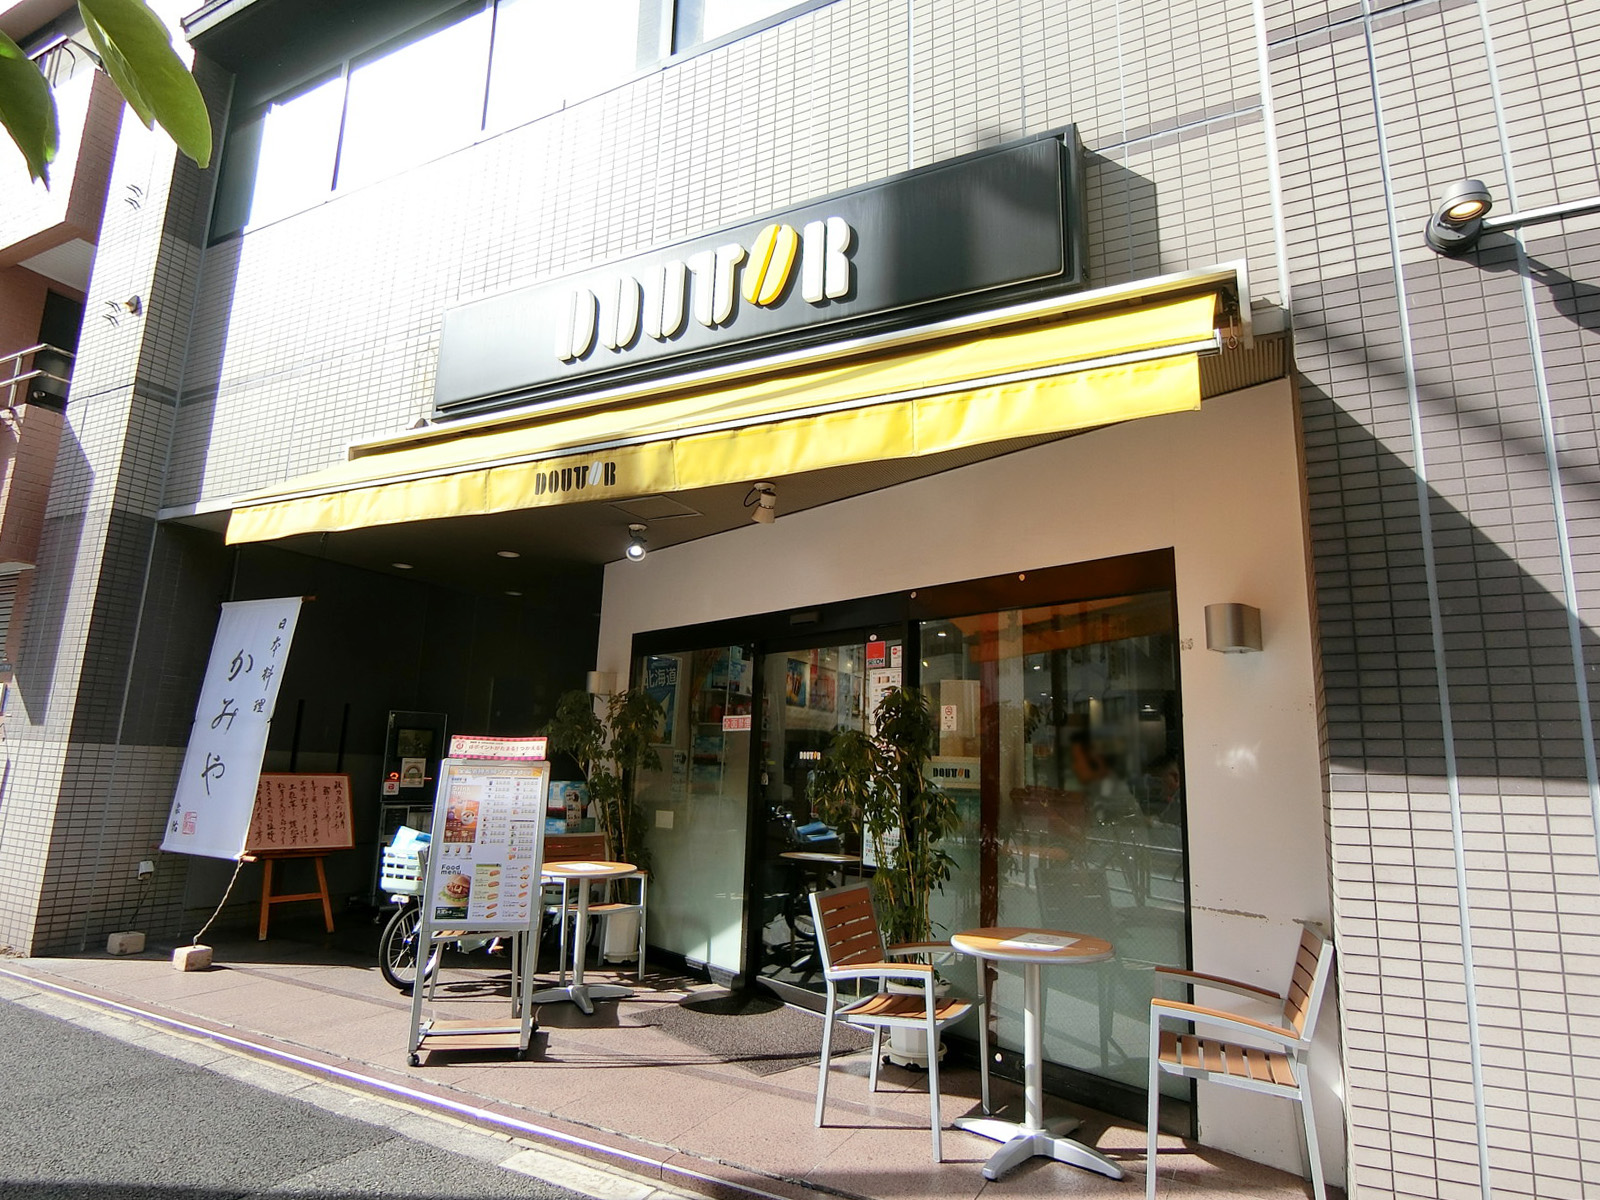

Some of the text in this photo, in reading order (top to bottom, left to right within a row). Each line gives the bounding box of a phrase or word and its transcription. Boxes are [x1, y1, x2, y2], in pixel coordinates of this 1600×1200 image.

[555, 215, 853, 362] DOUTOR
[534, 459, 617, 496] DOUTOR
[253, 617, 288, 713] 日本料理
[645, 668, 678, 689] 北海道
[201, 648, 254, 797] かみや
[932, 767, 971, 779] DOUTOR
